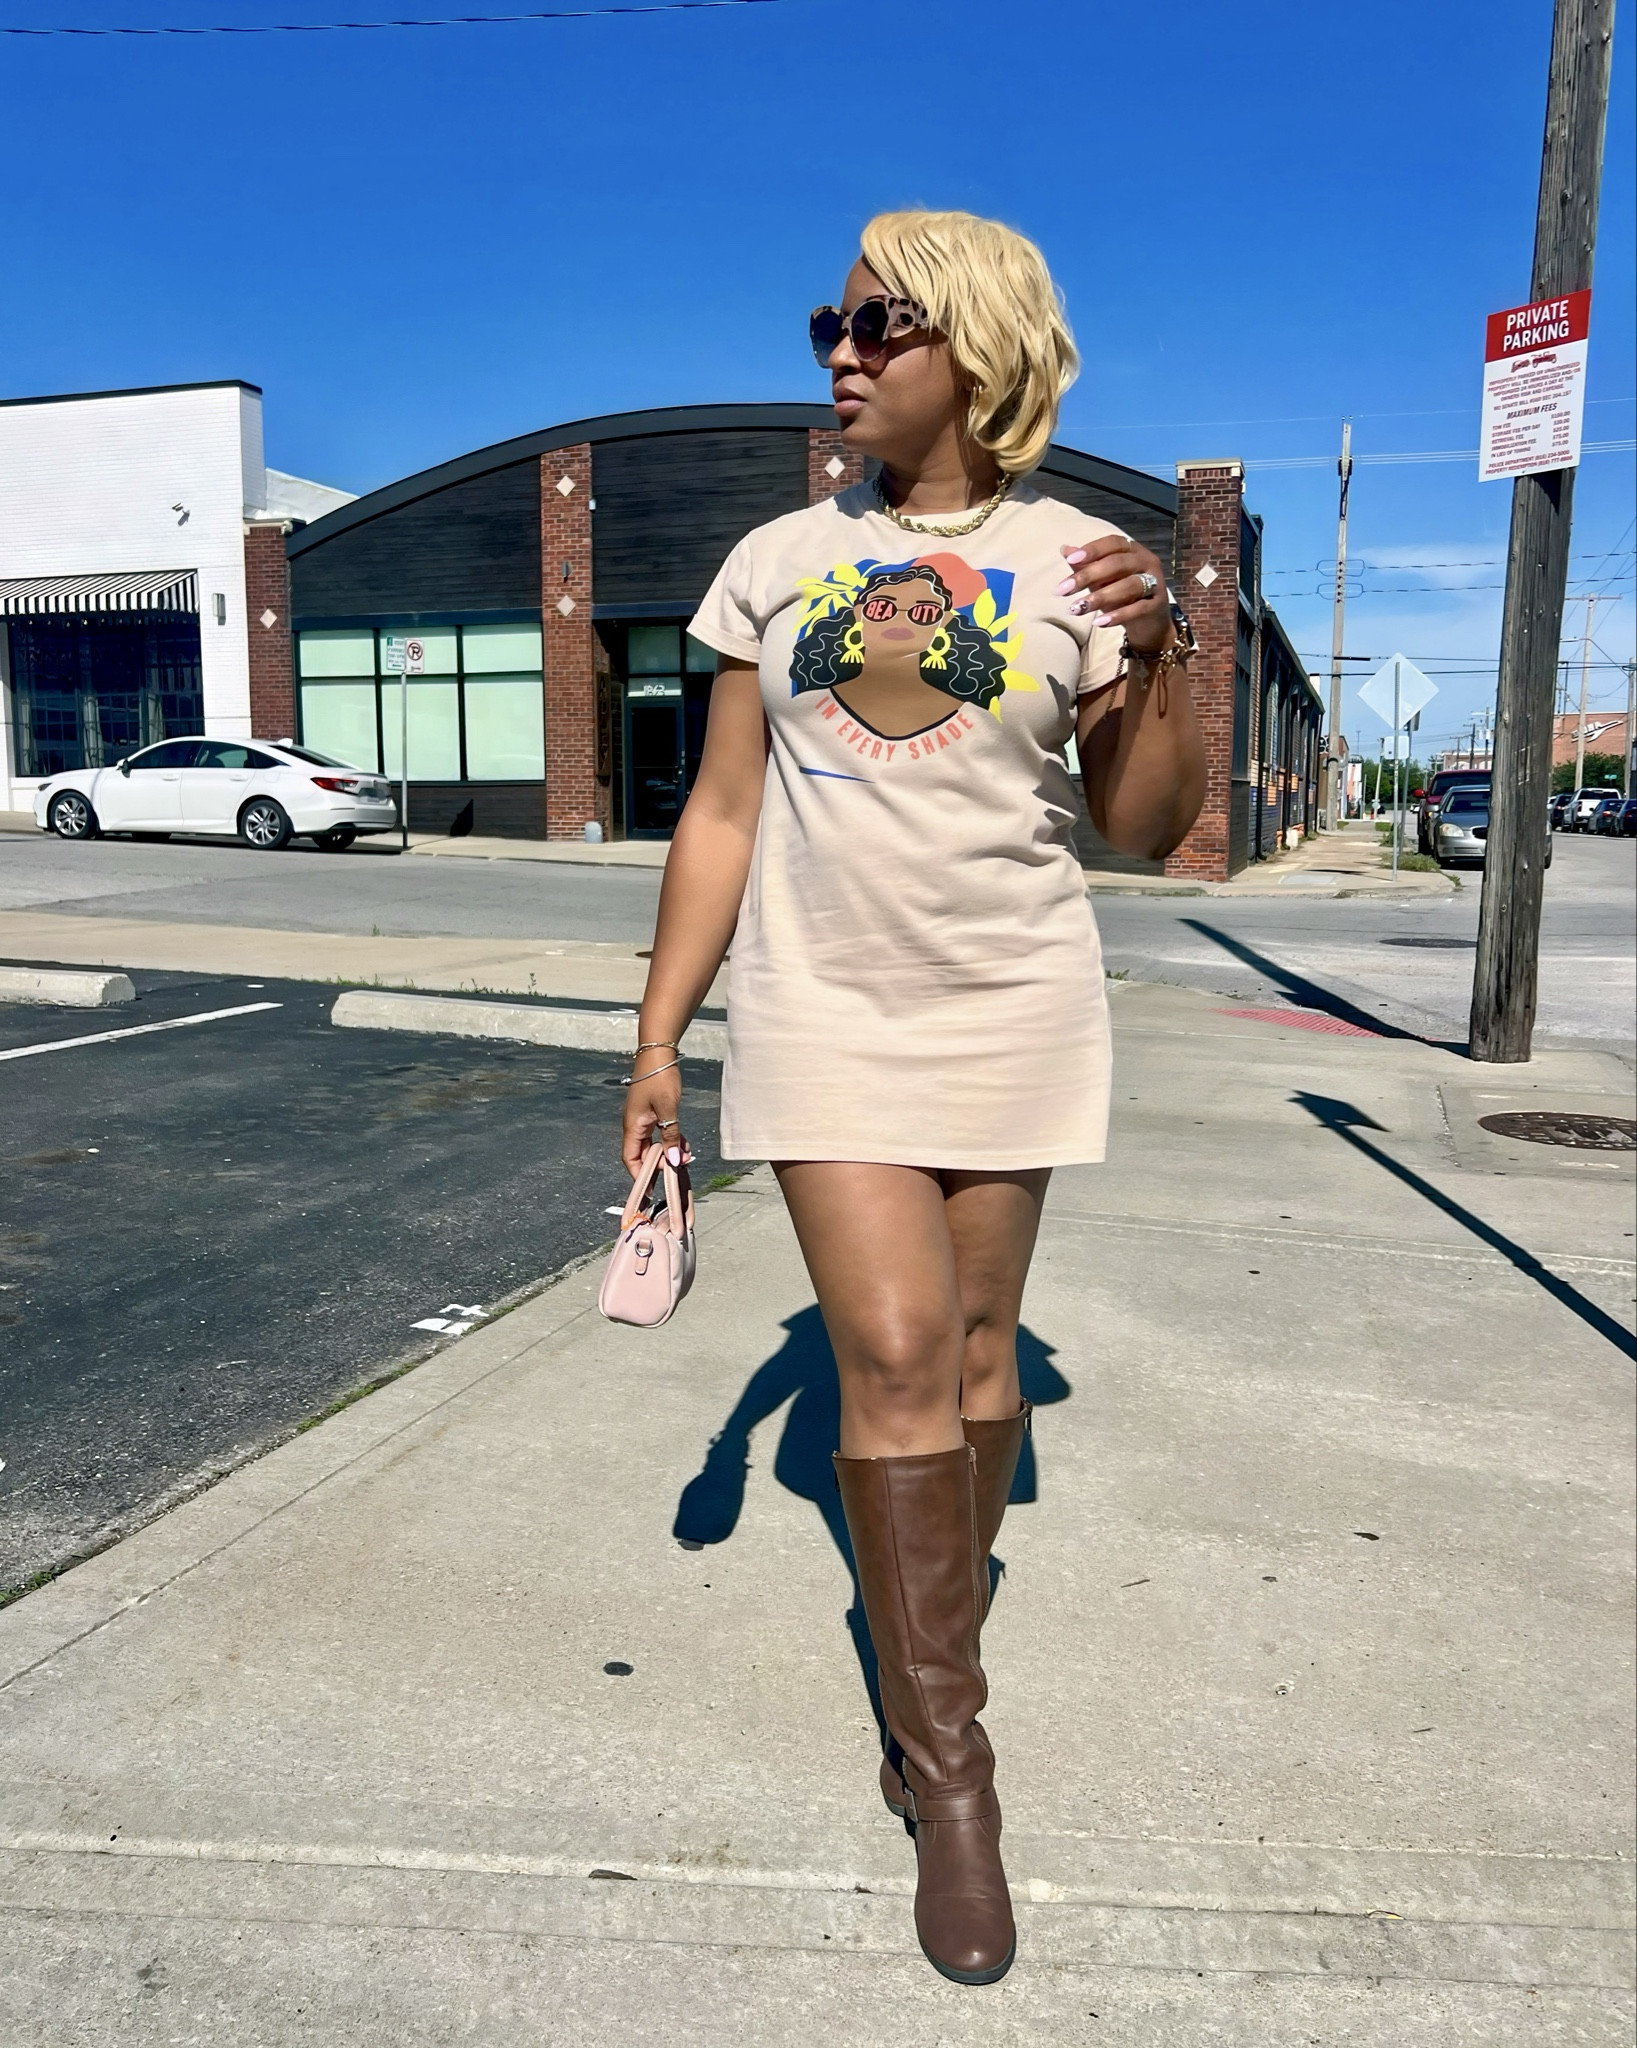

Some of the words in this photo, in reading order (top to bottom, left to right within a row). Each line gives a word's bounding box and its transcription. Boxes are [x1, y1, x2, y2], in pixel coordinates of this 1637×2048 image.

[1507, 300, 1569, 331] PRIVATE
[1504, 320, 1570, 351] PARKING
[1544, 362, 1580, 373] UNAUTHORIZED
[1530, 372, 1560, 382] IMMOBILIZED
[1494, 387, 1520, 396] IMPOUNDED
[1507, 407, 1540, 419] MAXIMUM
[1541, 403, 1557, 412] FEES
[1492, 441, 1527, 451] IMMOBILIZATION
[1505, 457, 1533, 465] DEPARTMENT
[815, 696, 840, 720] IN
[837, 720, 896, 762] EVERY
[908, 712, 974, 760] SHADE
